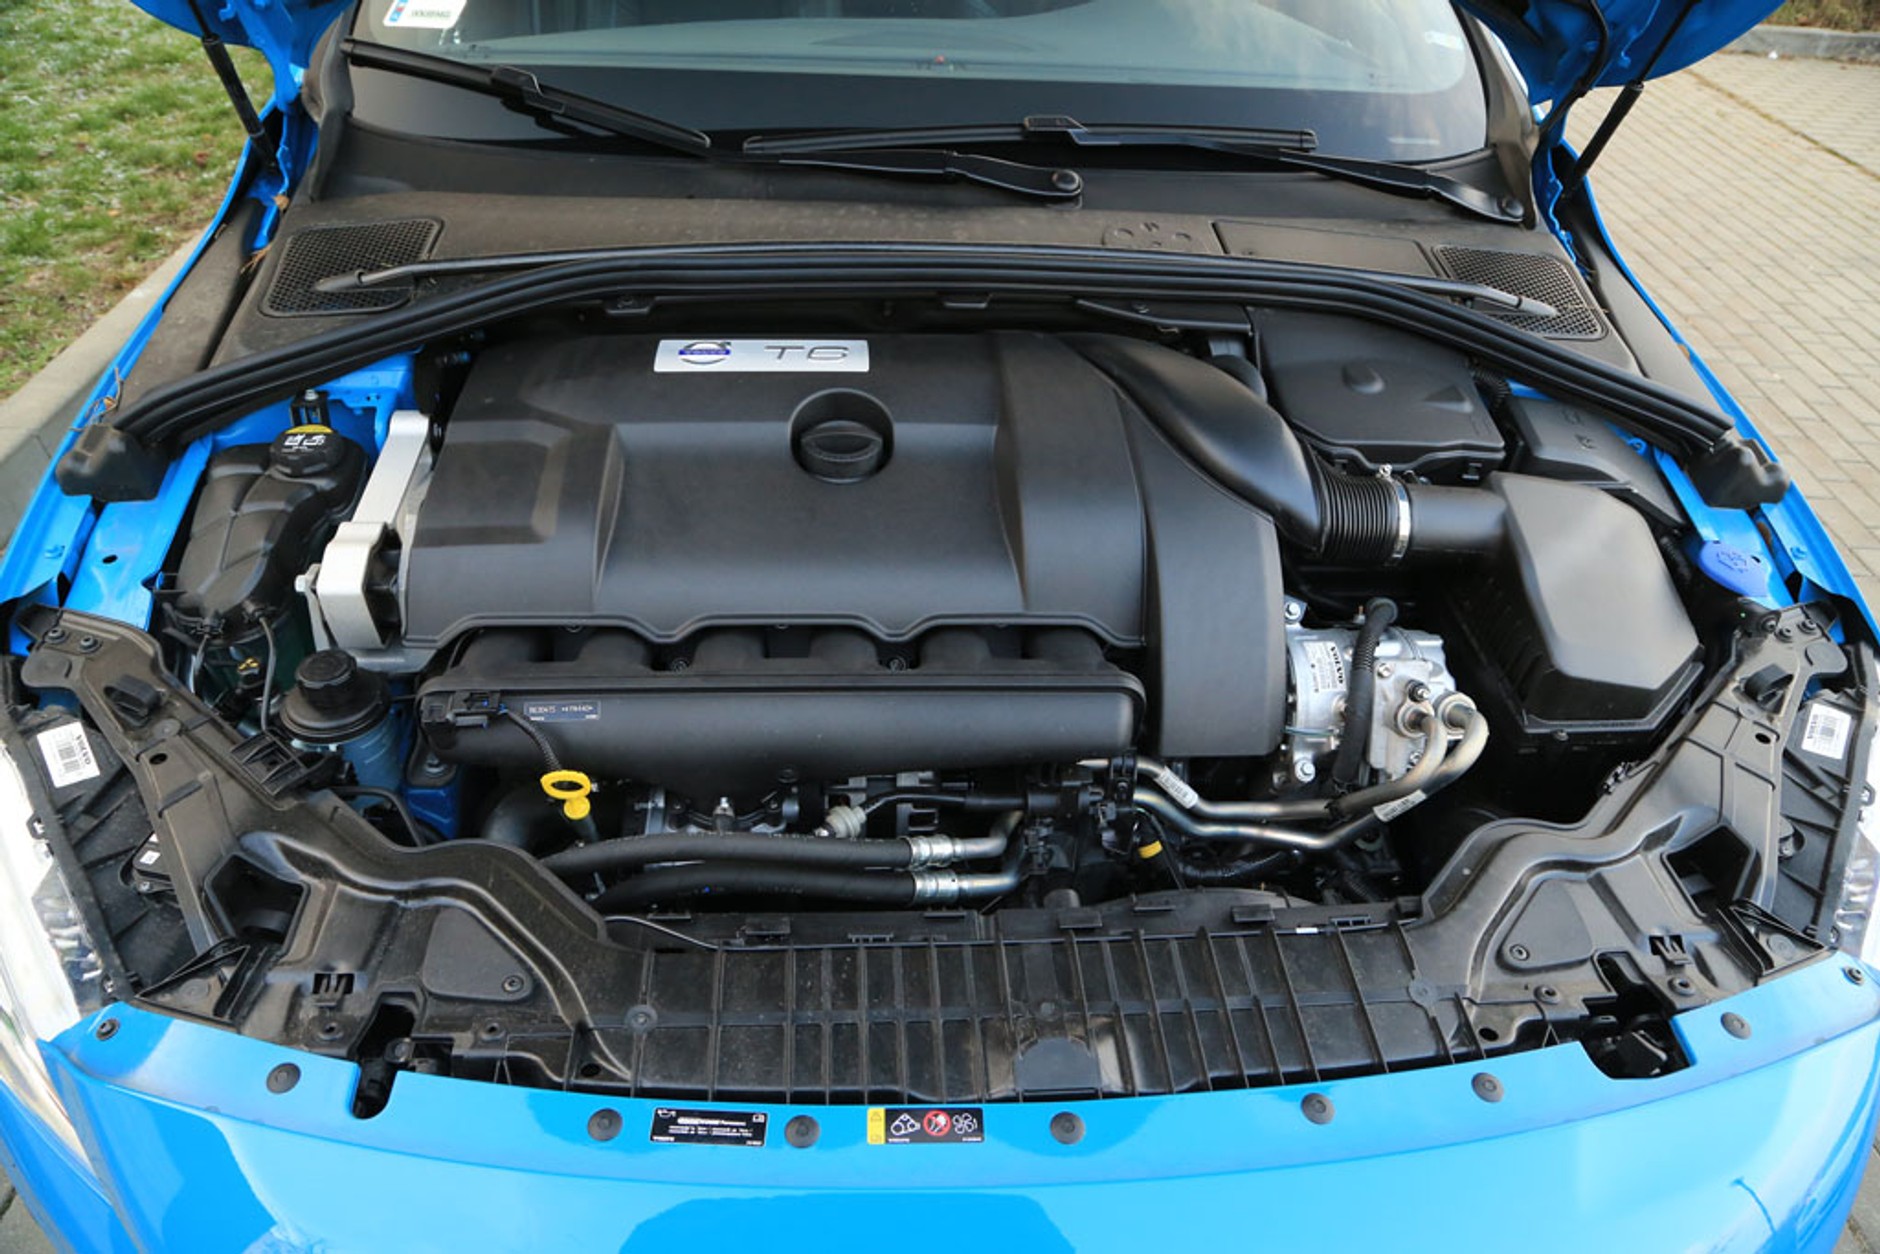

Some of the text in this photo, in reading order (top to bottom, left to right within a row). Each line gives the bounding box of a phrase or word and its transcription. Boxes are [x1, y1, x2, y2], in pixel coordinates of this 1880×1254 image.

[764, 345, 849, 361] T6
[1330, 645, 1344, 684] VOLVO
[75, 734, 92, 766] VOLVO
